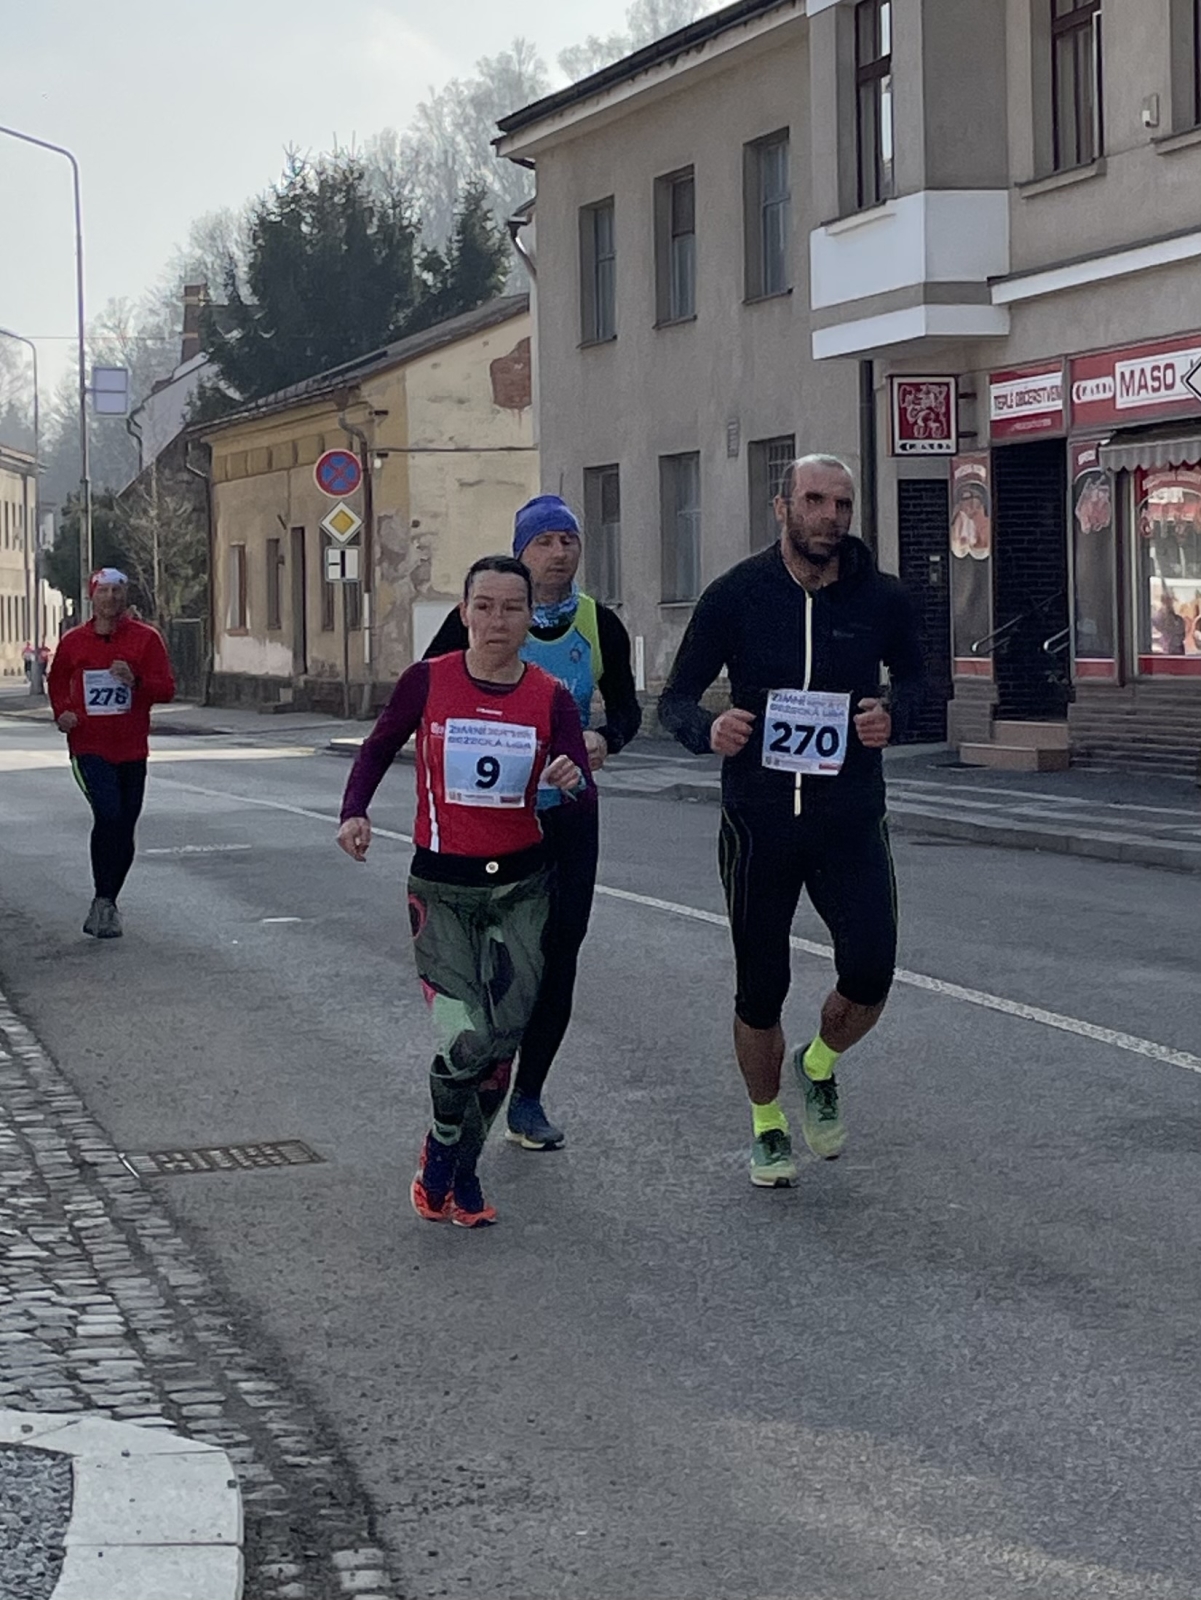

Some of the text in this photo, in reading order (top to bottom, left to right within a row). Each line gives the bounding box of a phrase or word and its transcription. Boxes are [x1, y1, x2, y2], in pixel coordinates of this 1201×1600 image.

[1120, 362, 1175, 398] MASO
[769, 721, 839, 757] 270
[475, 755, 501, 789] 9
